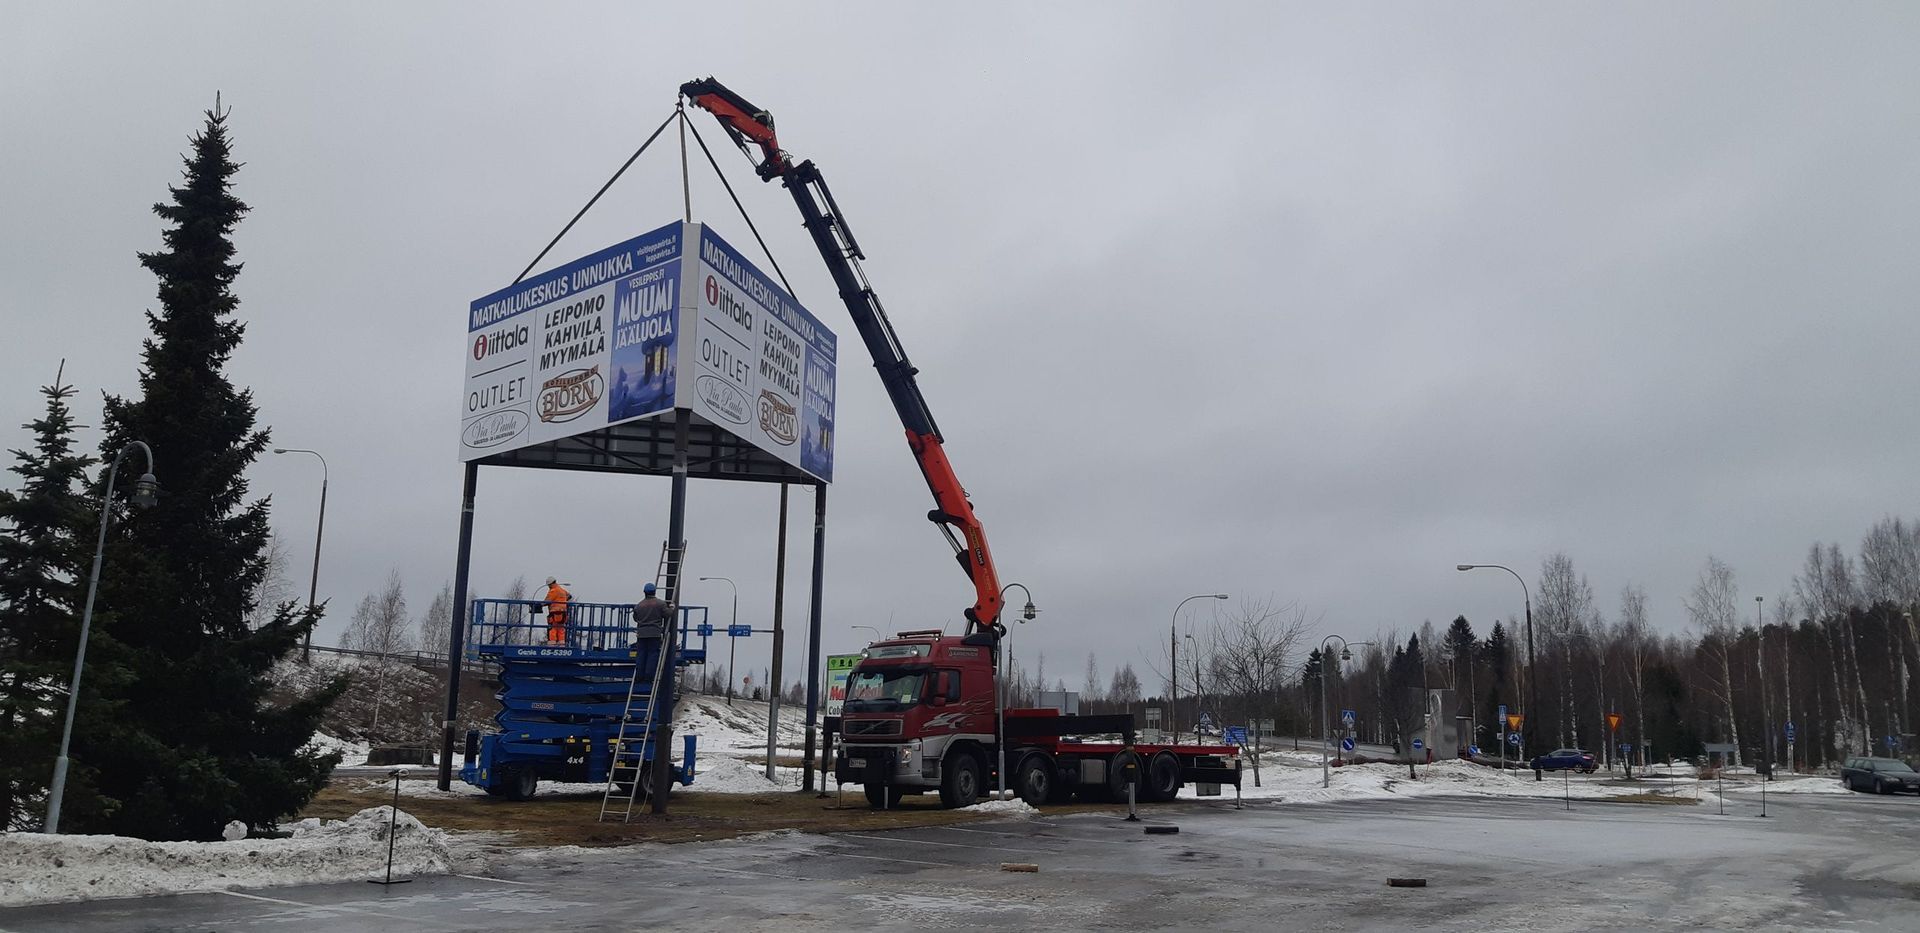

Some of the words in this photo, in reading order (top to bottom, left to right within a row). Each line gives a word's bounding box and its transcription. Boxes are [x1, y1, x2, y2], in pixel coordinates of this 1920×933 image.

[472, 276, 568, 328] MATKAILUKESKUS
[572, 251, 633, 290] UNNUKKA
[629, 268, 665, 289] VESILEPPIS.FI
[704, 238, 780, 315] MATKAILUKESKUS
[781, 301, 816, 344] UNNUKKA
[545, 294, 605, 329] LEIPOMO
[618, 278, 675, 326] MUUMI
[719, 285, 753, 333] iittala
[487, 324, 529, 356] iittala
[540, 331, 605, 372] MYYMÄLÄ
[545, 317, 601, 349] KAHVILA
[615, 317, 672, 349] JÄÄLUOLA
[763, 319, 800, 360] LEIPOMO
[702, 338, 750, 387] OUTLET
[759, 359, 800, 400] MYYMÄLÄ
[763, 341, 799, 379] KAHVILA
[469, 377, 526, 412] OUTLET
[566, 755, 584, 764] 4x4
